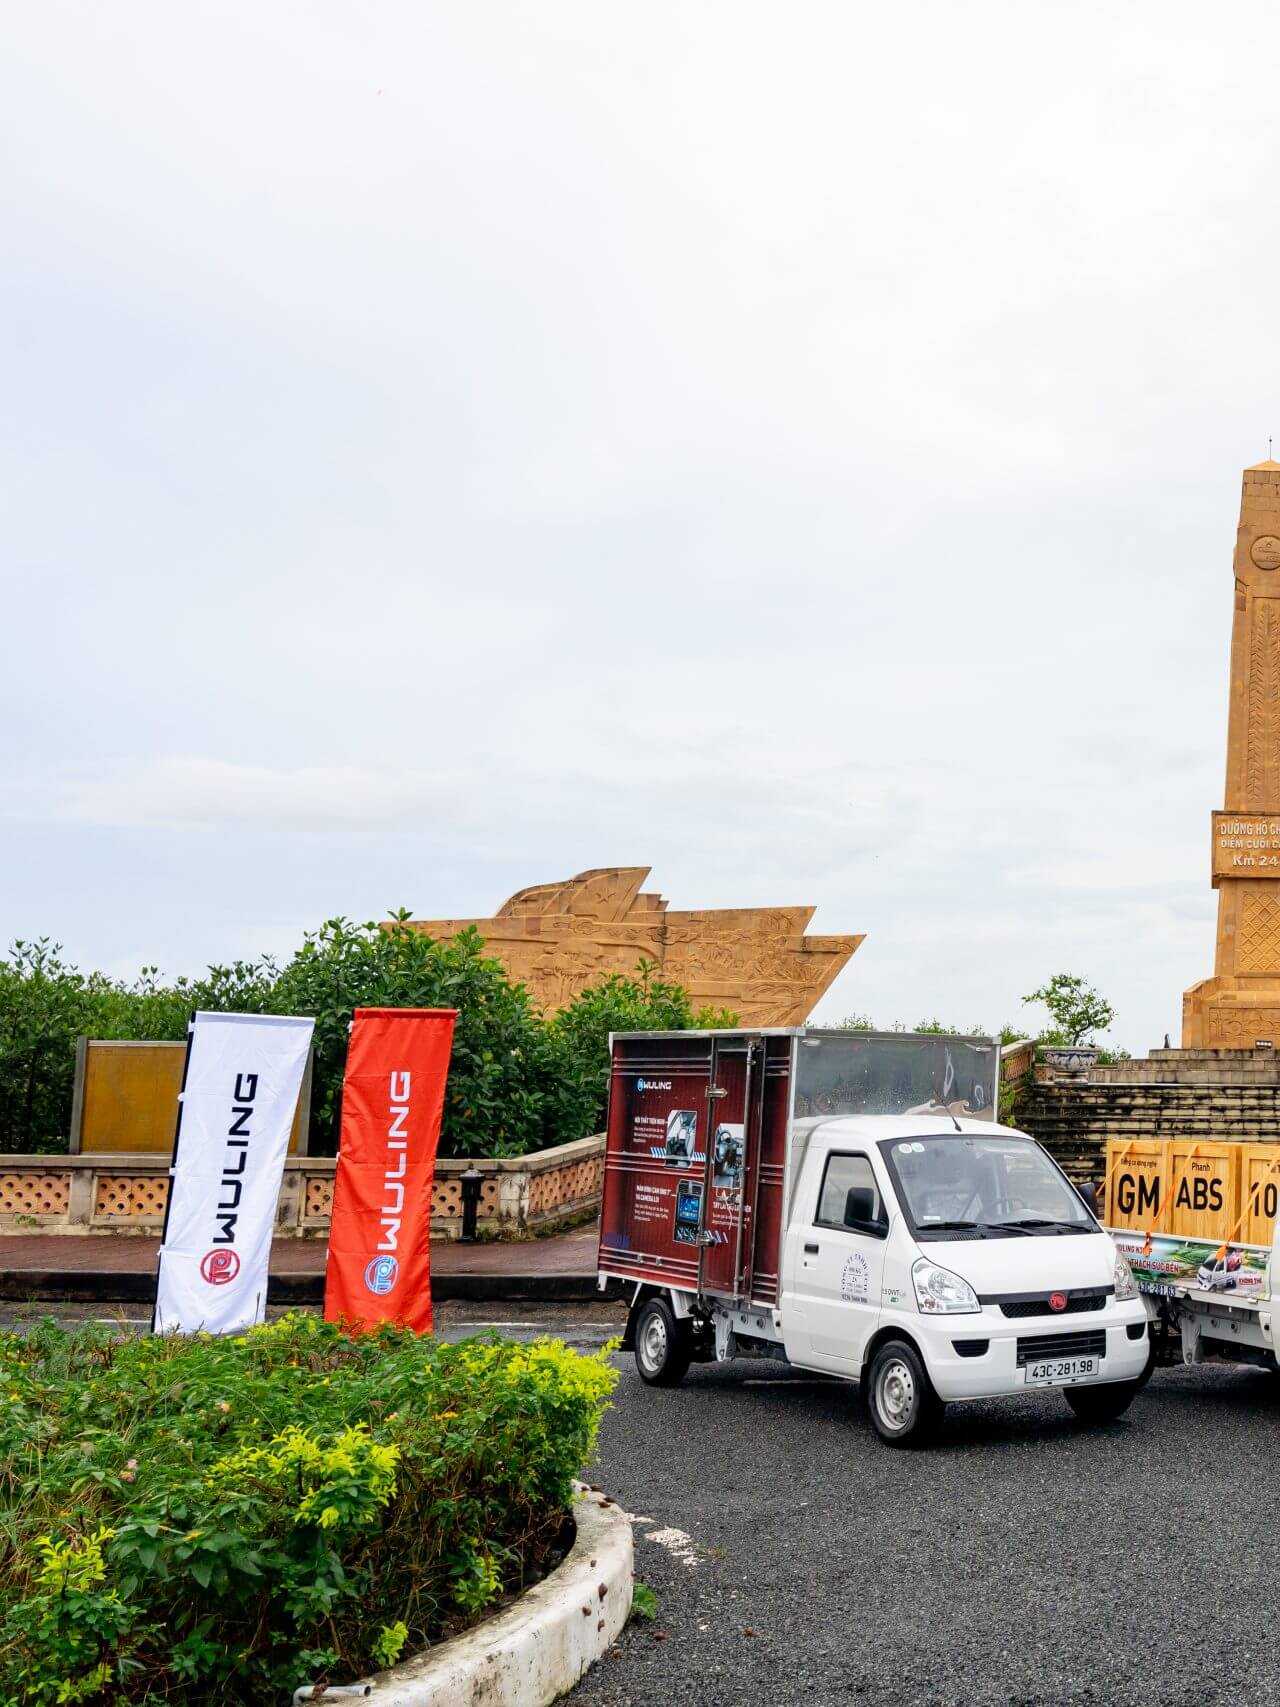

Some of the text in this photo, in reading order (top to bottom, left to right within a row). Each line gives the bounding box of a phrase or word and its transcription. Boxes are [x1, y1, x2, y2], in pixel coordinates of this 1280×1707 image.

[1232, 855, 1255, 866] Km
[643, 1081, 672, 1090] WULING
[212, 1073, 259, 1244] WULING
[376, 1070, 411, 1251] WULING
[1191, 1162, 1211, 1172] Phanh
[1118, 1173, 1160, 1217] GM
[1176, 1176, 1223, 1212] ABS
[1250, 1181, 1280, 1219] 10
[1032, 1360, 1093, 1378] 43C-281.98
